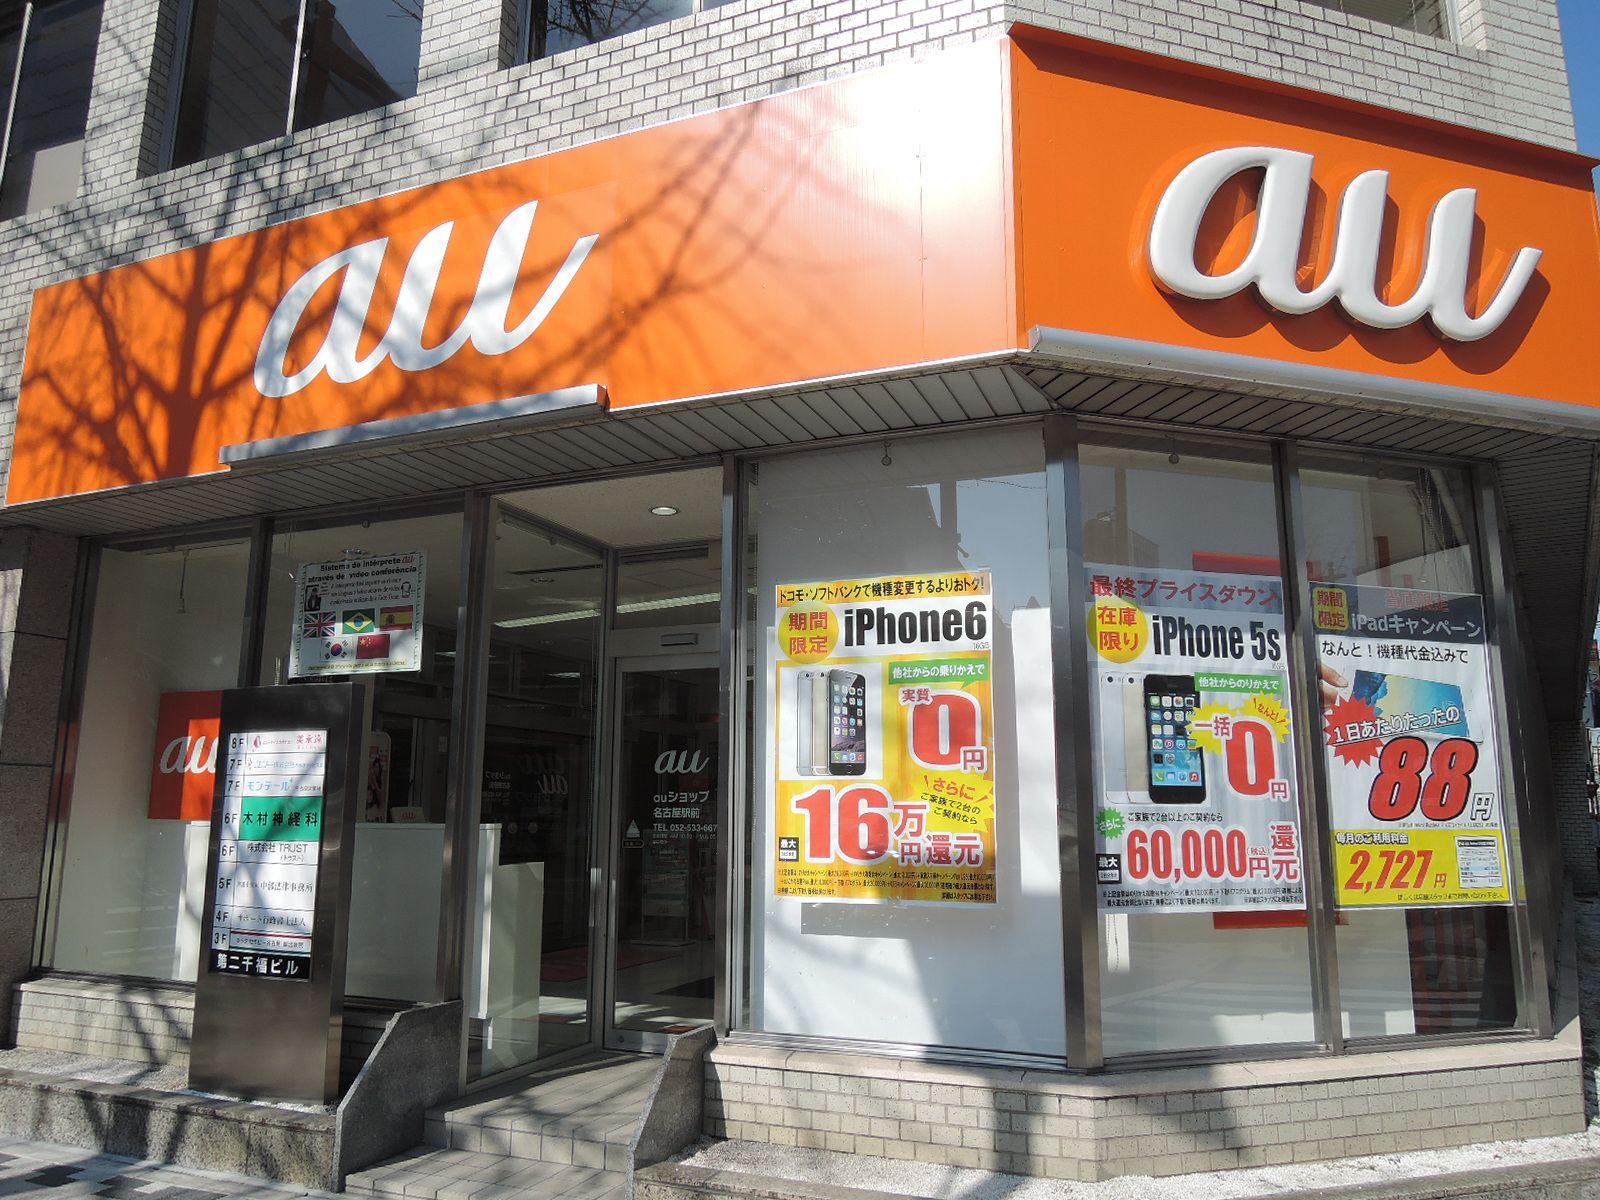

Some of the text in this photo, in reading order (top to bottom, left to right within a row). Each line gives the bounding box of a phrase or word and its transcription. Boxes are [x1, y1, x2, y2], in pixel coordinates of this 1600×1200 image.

[1149, 146, 1542, 344] au
[253, 199, 599, 398] au
[336, 572, 345, 580] de
[1089, 575, 1278, 606] 最終プライスダウン
[1317, 590, 1343, 608] 期間
[789, 611, 828, 631] 期間
[845, 601, 987, 646] iPhone6
[1097, 607, 1138, 627] 在庫
[1318, 611, 1346, 628] 限定
[1351, 613, 1481, 638] iPadキャンペーン
[789, 636, 828, 655] 限定
[1099, 632, 1139, 652] 限り
[1152, 615, 1281, 662] iPhone 5s
[893, 664, 984, 679] 他社からの乗りかえで
[1199, 677, 1279, 691] 他社からのりかえで
[901, 688, 931, 702] 実質
[1195, 716, 1230, 736] 一括
[1333, 705, 1460, 742] 1日あたりたったの
[231, 737, 244, 749] 8F
[160, 736, 219, 774] au
[654, 749, 710, 774] au
[229, 759, 242, 770] 7F
[228, 780, 240, 791] 7F
[933, 777, 976, 799] さらに
[653, 790, 710, 803] auショップ
[920, 792, 981, 815] ご家族で2台の
[224, 811, 318, 827] 6F 木村神経科
[653, 807, 701, 819] 名古屋駅前
[933, 805, 978, 825] ご契約なら
[1127, 811, 1223, 823] ご家族で2台以上のご契約なら
[653, 823, 668, 832] TEL
[1099, 819, 1121, 831] さらに
[780, 839, 797, 849] 最大
[1336, 832, 1409, 845] 毎月のご利用料金
[222, 843, 309, 856] 6F 株式会社 TRUST
[1270, 825, 1298, 880] 還元
[1098, 857, 1118, 868] 最大
[218, 878, 232, 889] 5F
[216, 910, 229, 922] 4F
[214, 933, 227, 944] 3F
[217, 953, 299, 974] 第二千福ビル
